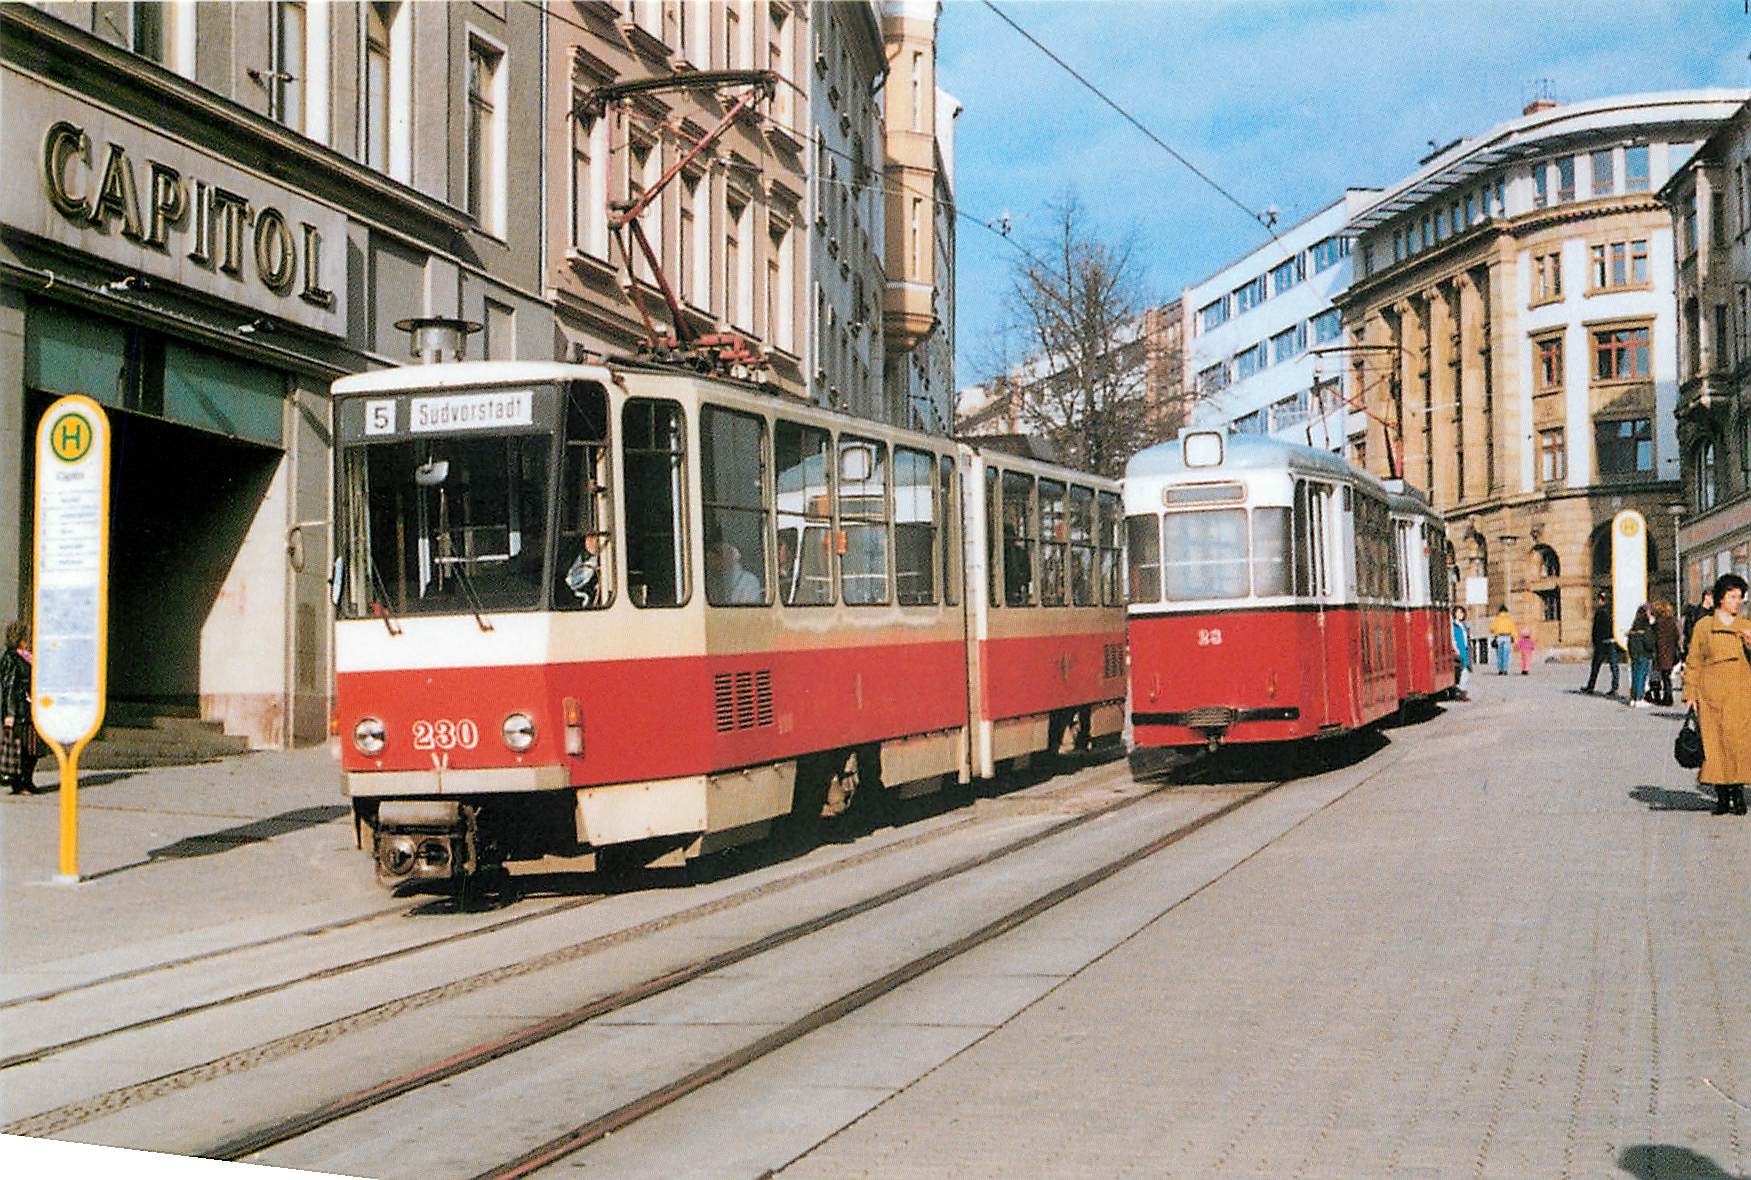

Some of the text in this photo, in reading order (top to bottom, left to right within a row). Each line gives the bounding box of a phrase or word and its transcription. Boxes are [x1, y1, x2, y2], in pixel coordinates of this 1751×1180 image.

[43, 121, 334, 309] CAPITOL
[373, 406, 389, 430] 5
[61, 424, 81, 451] H
[412, 719, 478, 750] 230
